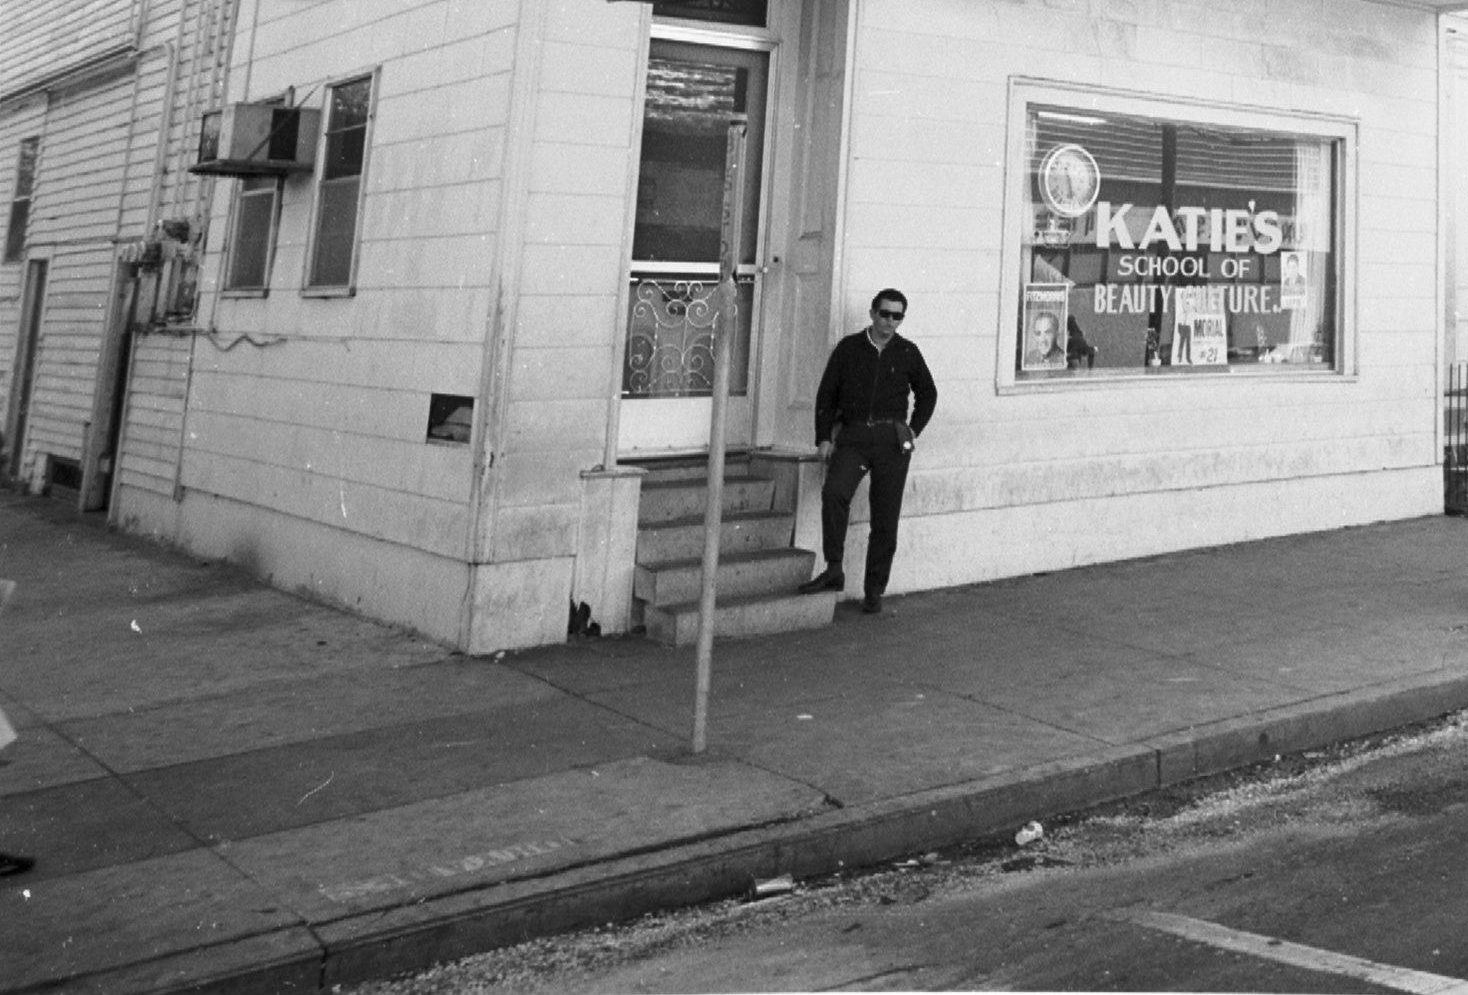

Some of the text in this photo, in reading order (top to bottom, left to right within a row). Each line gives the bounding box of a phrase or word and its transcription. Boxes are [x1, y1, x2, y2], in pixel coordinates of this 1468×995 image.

[1096, 200, 1284, 254] KATIE'S
[1117, 256, 1251, 279] SCHOOL OF
[1094, 283, 1172, 314] BEAUTY
